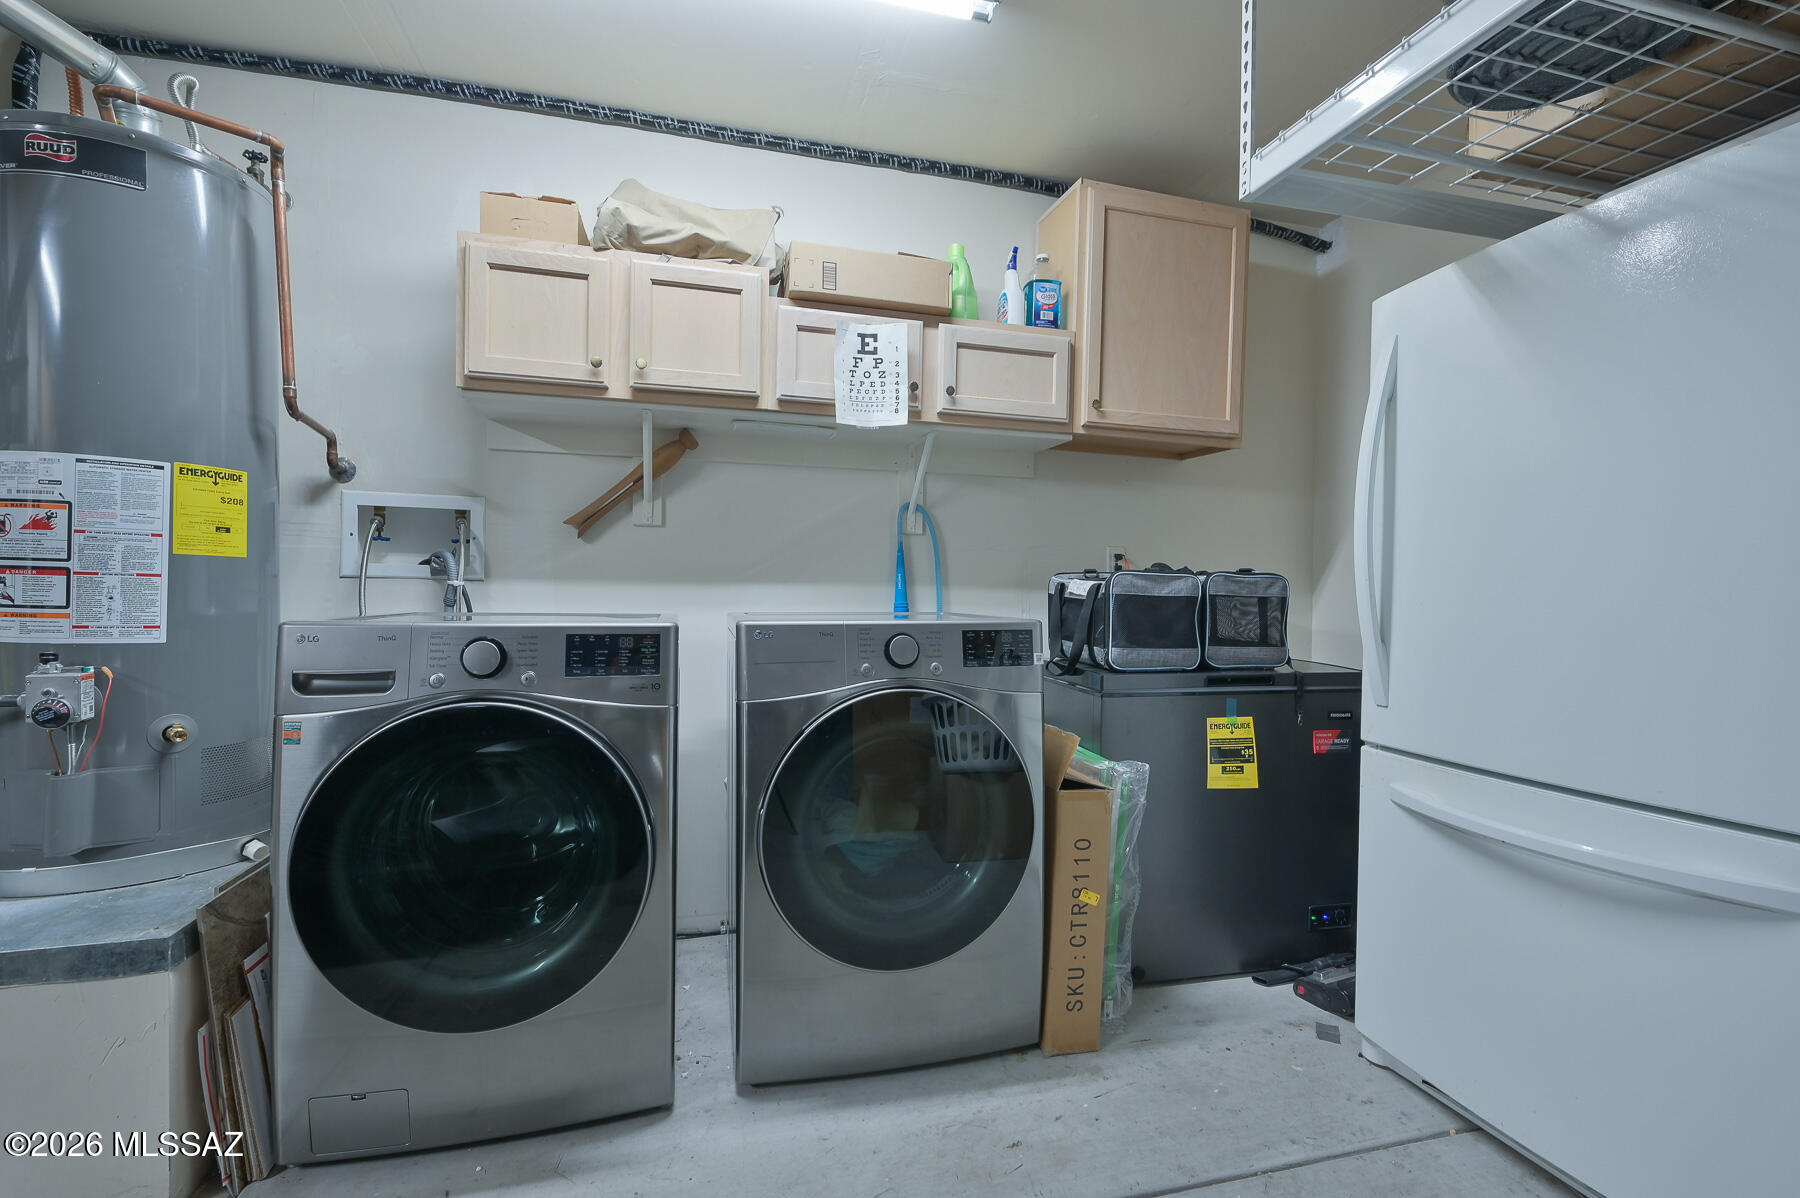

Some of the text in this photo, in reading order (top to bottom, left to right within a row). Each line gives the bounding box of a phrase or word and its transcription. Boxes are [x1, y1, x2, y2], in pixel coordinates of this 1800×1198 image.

[25, 141, 76, 156] RUUD
[81, 169, 144, 187] PROFESSIONAL
[857, 333, 878, 355] E
[178, 466, 244, 485] ENERGYGUIDE
[306, 635, 320, 643] LG
[1209, 722, 1252, 733] ENERGYGUIDE
